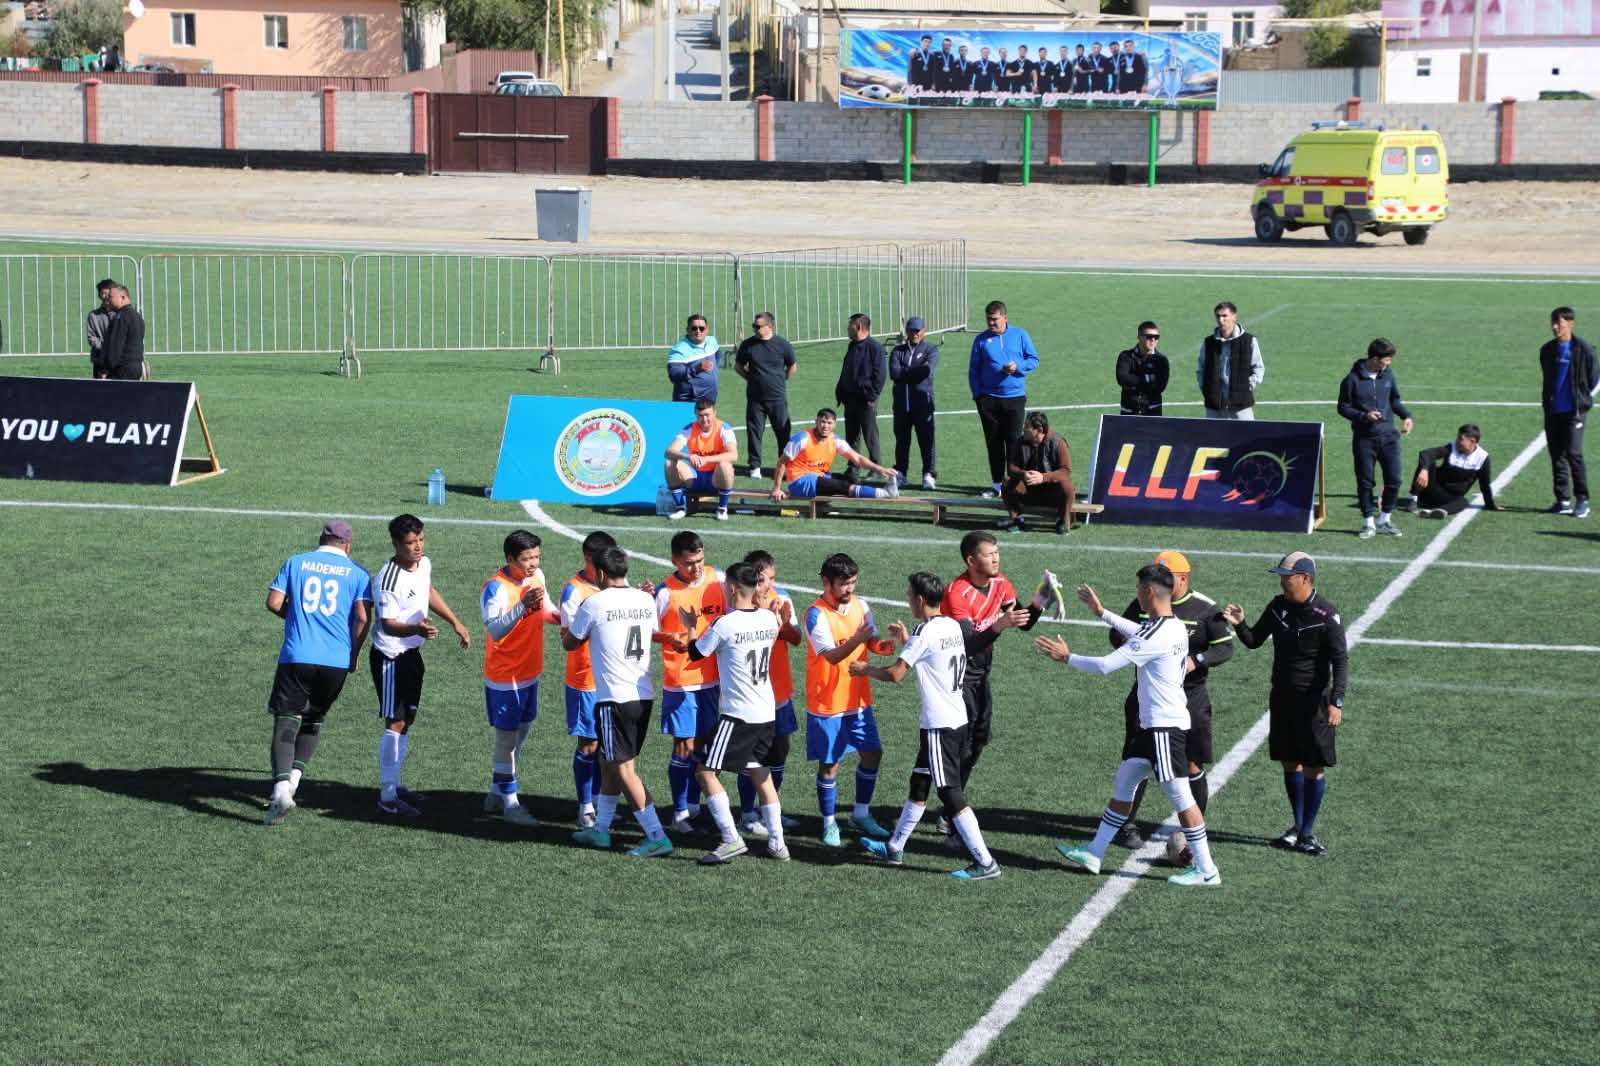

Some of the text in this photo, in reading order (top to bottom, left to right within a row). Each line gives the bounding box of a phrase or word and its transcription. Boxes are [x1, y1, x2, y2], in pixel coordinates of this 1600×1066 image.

[1, 418, 172, 446] YOU PLAY!
[1107, 443, 1230, 500] LLF
[301, 560, 352, 577] MADENIET
[302, 576, 339, 617] 93
[624, 625, 645, 662] 4
[745, 646, 769, 686] 14
